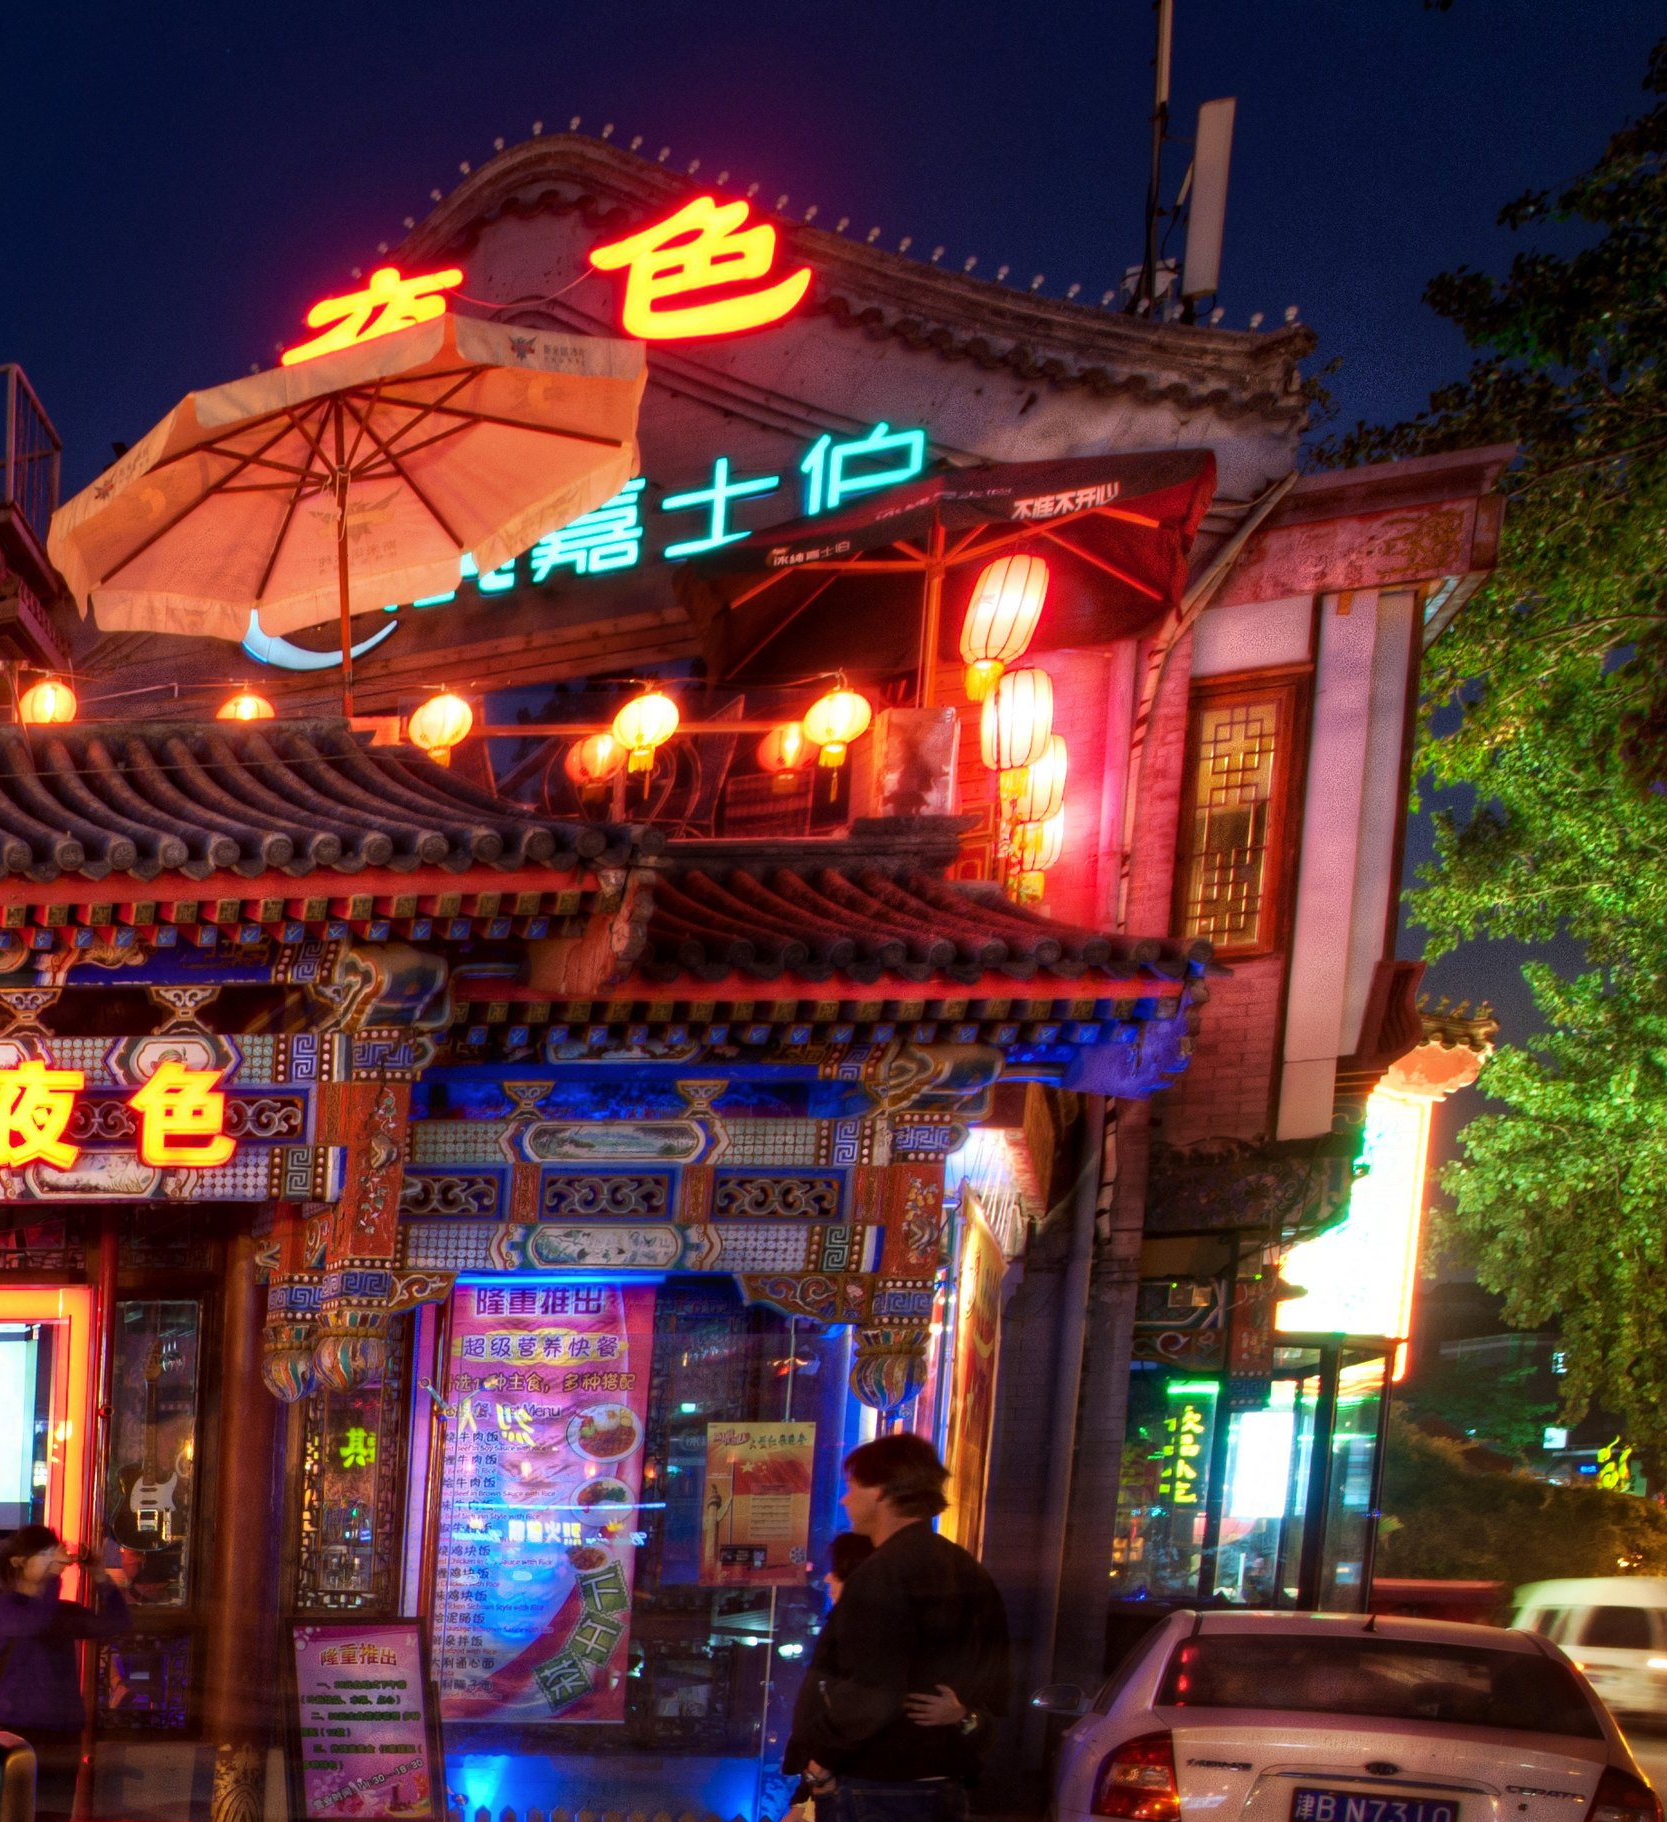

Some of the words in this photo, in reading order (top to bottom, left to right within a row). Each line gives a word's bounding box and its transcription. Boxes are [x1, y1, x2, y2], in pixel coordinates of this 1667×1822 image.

[475, 1285, 604, 1316] 隆重推出
[463, 1335, 619, 1359] 超级营养快餐
[320, 1642, 398, 1667] 隆重推出
